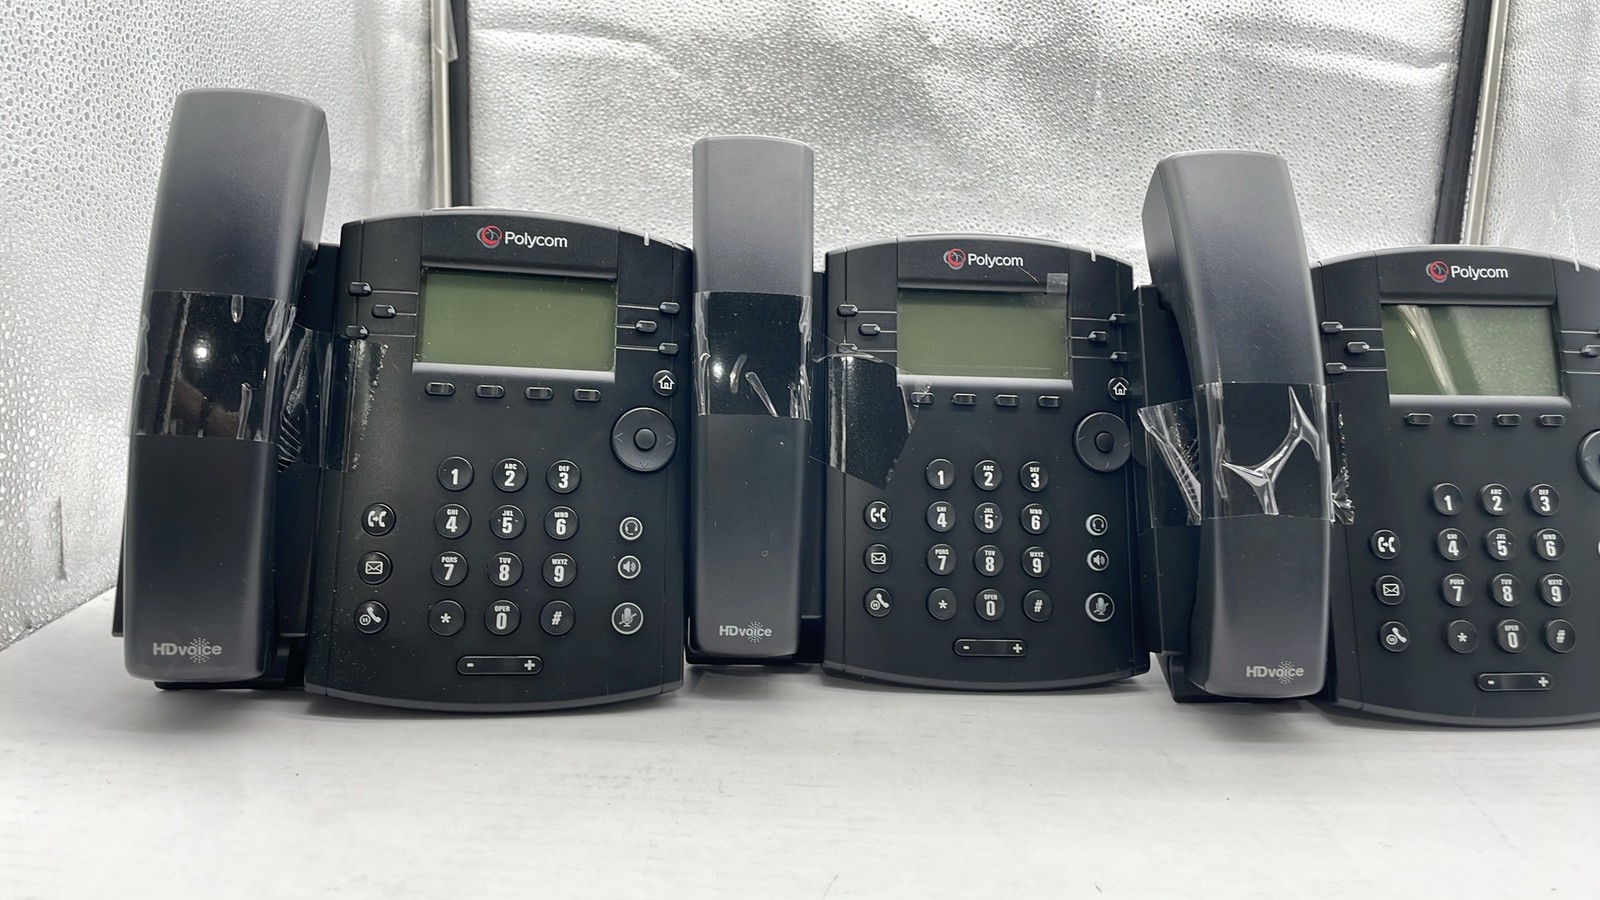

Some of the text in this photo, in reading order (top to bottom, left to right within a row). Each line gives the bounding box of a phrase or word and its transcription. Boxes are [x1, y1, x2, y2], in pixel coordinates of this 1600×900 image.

[504, 231, 568, 249] Polycom
[968, 253, 1024, 269] Polycom
[1450, 265, 1509, 281] Polycom
[451, 469, 459, 485] 1
[504, 470, 516, 486] 2
[558, 473, 569, 488] 3
[938, 470, 944, 485] 1
[984, 472, 993, 486] 2
[1030, 473, 1040, 488] 3
[1444, 495, 1452, 511] 1
[1492, 496, 1503, 511] 2
[1540, 496, 1550, 512] 3
[446, 516, 457, 532] 4
[502, 517, 513, 533] 5
[556, 519, 566, 535] 6
[937, 513, 947, 527] 4
[984, 514, 993, 529] 5
[1031, 515, 1041, 530] 6
[1448, 540, 1459, 556] 4
[1497, 540, 1508, 556] 5
[1546, 541, 1556, 557] 6
[937, 556, 947, 570] 7
[985, 557, 995, 572] 8
[1032, 558, 1042, 573] 9
[443, 564, 454, 580] 7
[499, 564, 510, 581] 8
[554, 566, 564, 582] 9
[1452, 586, 1462, 602] 7
[1502, 586, 1513, 602] 8
[1551, 586, 1561, 602] 9
[986, 601, 996, 616] 0
[1034, 600, 1043, 613] #
[496, 613, 507, 630] 0
[552, 611, 562, 626] #
[719, 623, 773, 639] HDvoice
[1556, 630, 1565, 643] #
[1508, 632, 1518, 649] 0
[152, 640, 223, 658] HDvoice
[1246, 663, 1304, 680] HDvoice
